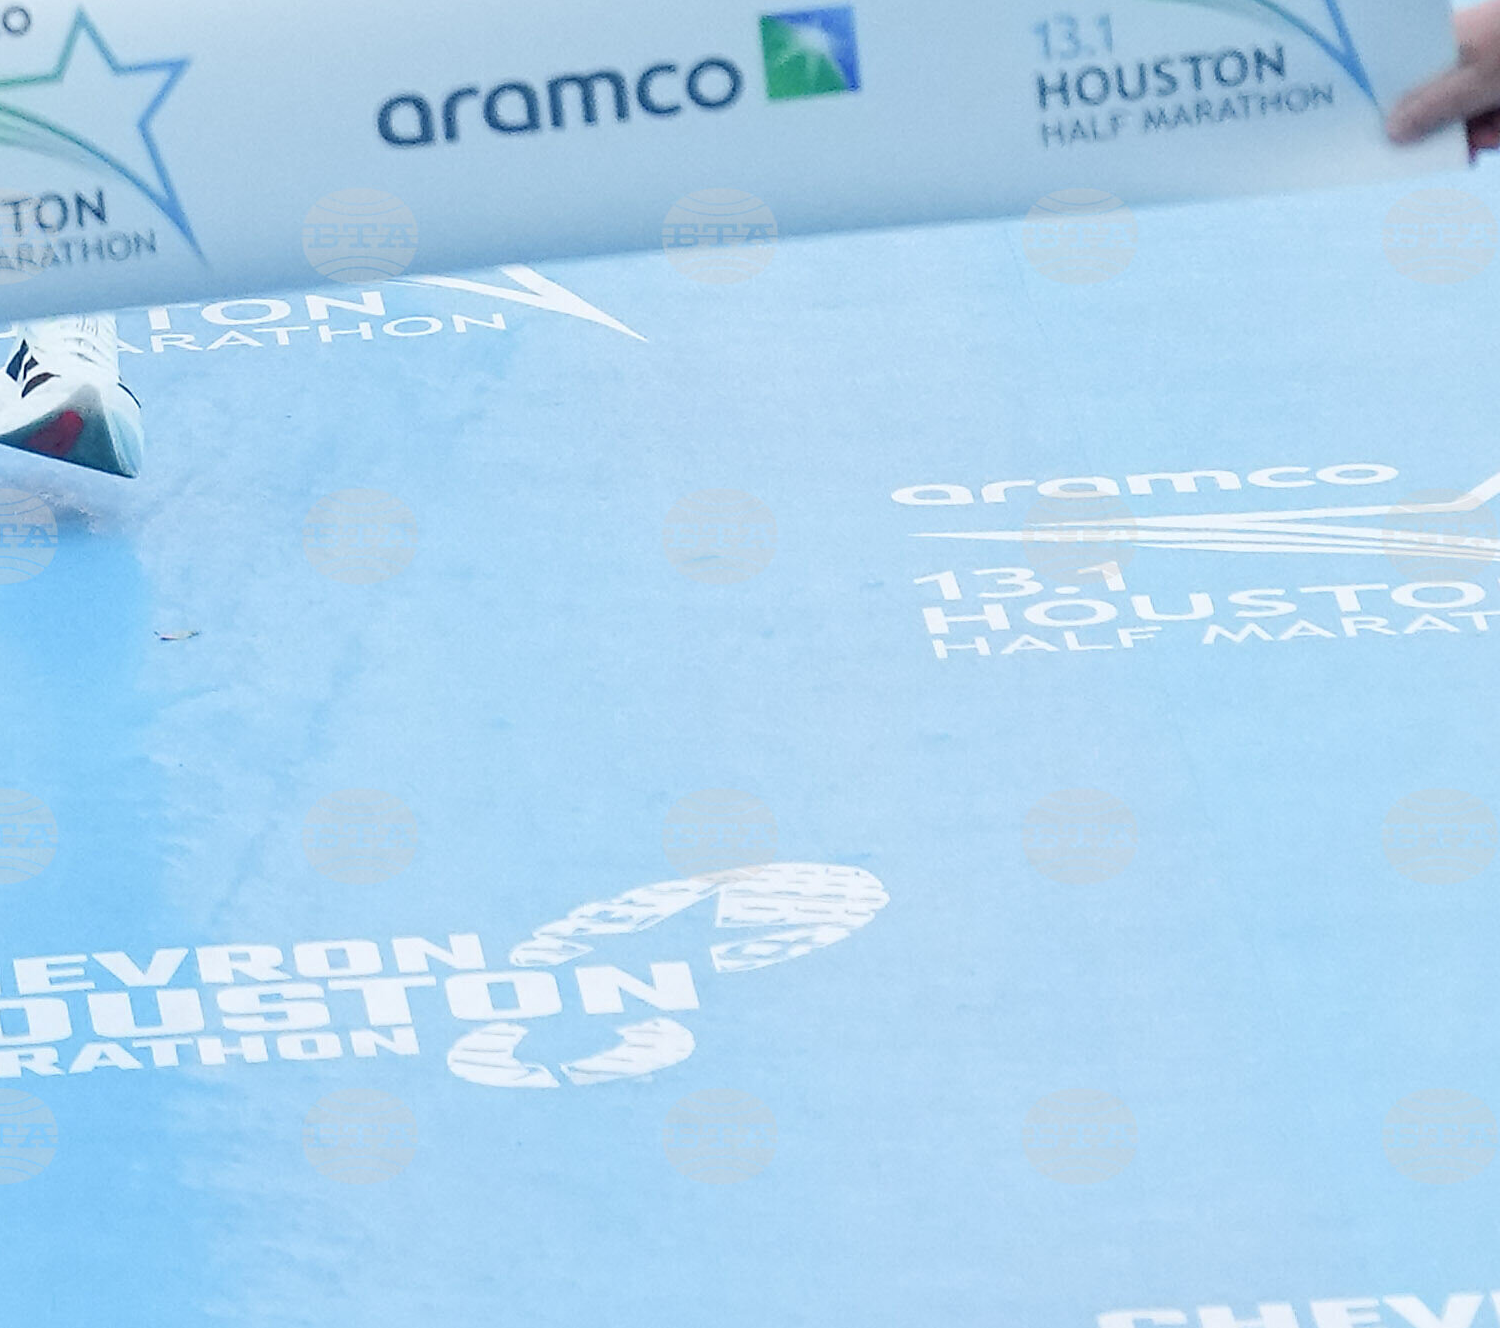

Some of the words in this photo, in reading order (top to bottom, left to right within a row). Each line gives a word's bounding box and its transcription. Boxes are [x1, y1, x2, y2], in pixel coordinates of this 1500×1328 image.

[1034, 12, 1113, 61] 13.1
[375, 56, 746, 148] aramco
[1036, 45, 1287, 111] HOUSTON
[1040, 109, 1128, 148] HALF
[1143, 84, 1334, 132] MARATHON
[890, 462, 1400, 506] aramco
[912, 560, 1127, 601] 13.1
[921, 578, 1500, 636] HOUSTO
[931, 625, 1164, 660] HALF
